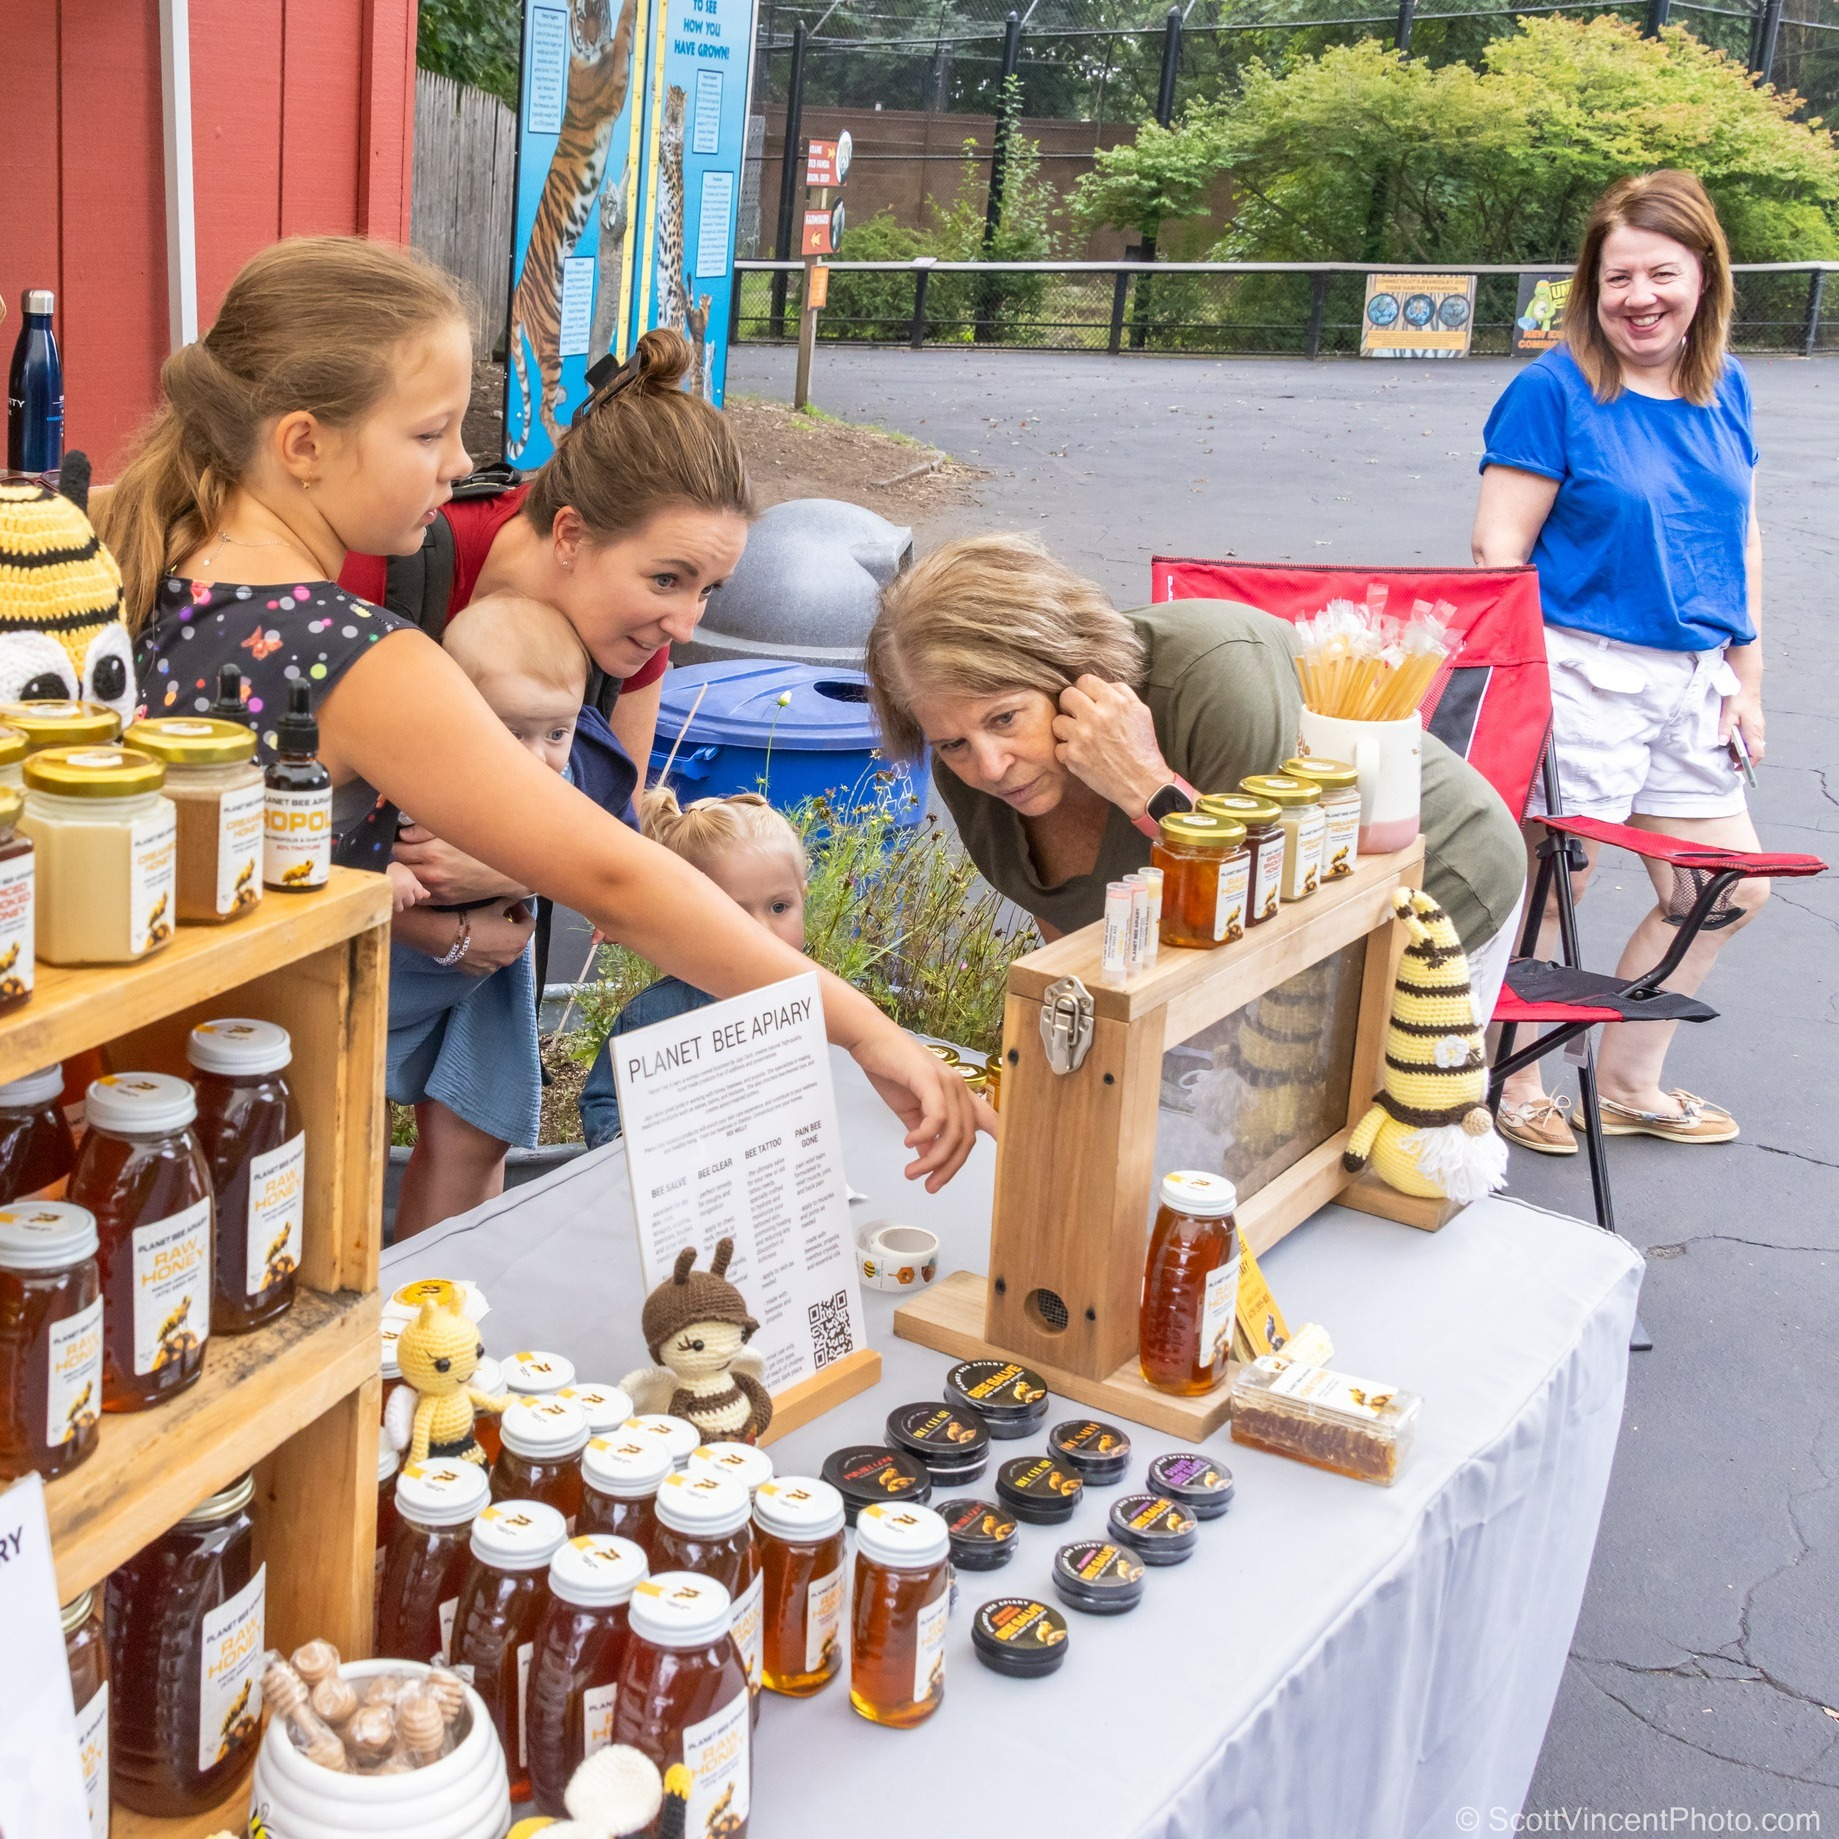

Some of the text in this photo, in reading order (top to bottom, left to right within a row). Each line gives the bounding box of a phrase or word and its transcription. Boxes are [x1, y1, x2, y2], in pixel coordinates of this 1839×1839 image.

[693, 0, 717, 14] TO SEE
[683, 18, 721, 37] HOW YOU
[674, 39, 730, 60] HAVE GROWN!
[1523, 330, 1546, 339] NEW
[264, 795, 310, 807] LANET BEE
[1332, 825, 1353, 833] HONEY
[1221, 881, 1248, 896] HONEY
[1227, 874, 1247, 885] RAW
[1131, 940, 1139, 962] PLANET
[630, 998, 811, 1081] PLANET BEE APIARY
[794, 1120, 821, 1137] PAIN BEE
[744, 1136, 782, 1159] BEE TATTOO
[801, 1134, 818, 1147] GONE
[253, 1165, 279, 1181] PLANET
[697, 1157, 733, 1179] BEE CLEAR
[265, 1167, 297, 1195] RAW
[651, 1176, 688, 1199] BEE SALVE
[254, 1177, 301, 1213] HONEY
[137, 1236, 171, 1253] PLANET
[172, 1229, 185, 1241] BEE
[154, 1234, 198, 1267] RAW
[141, 1243, 206, 1288] HONEY
[66, 1330, 96, 1356] RAW
[958, 1364, 971, 1374] BEE
[967, 1382, 995, 1399] BEE
[985, 1363, 1023, 1387] SALVE
[912, 1427, 930, 1439] BEE
[924, 1410, 951, 1429] CLEAR
[1014, 1475, 1032, 1488] BEE
[1027, 1459, 1053, 1478] CLEAR
[1128, 1515, 1152, 1530] BEE
[1142, 1498, 1172, 1519] SALVE
[1063, 1548, 1075, 1558] BEE
[1073, 1542, 1102, 1551] APIARY
[1079, 1564, 1101, 1581] BEE
[1090, 1544, 1118, 1568] SALVE
[984, 1603, 998, 1614] BEE
[998, 1599, 1029, 1607] APIARY
[206, 1608, 249, 1644] PLANET BEE
[221, 1610, 258, 1656] RAW
[994, 1622, 1020, 1641] BEE
[1010, 1602, 1045, 1627] SALVE
[208, 1625, 260, 1679] HONEY
[588, 1700, 613, 1712] PLAN
[688, 1731, 716, 1751] PLANET
[702, 1727, 740, 1761] RAW
